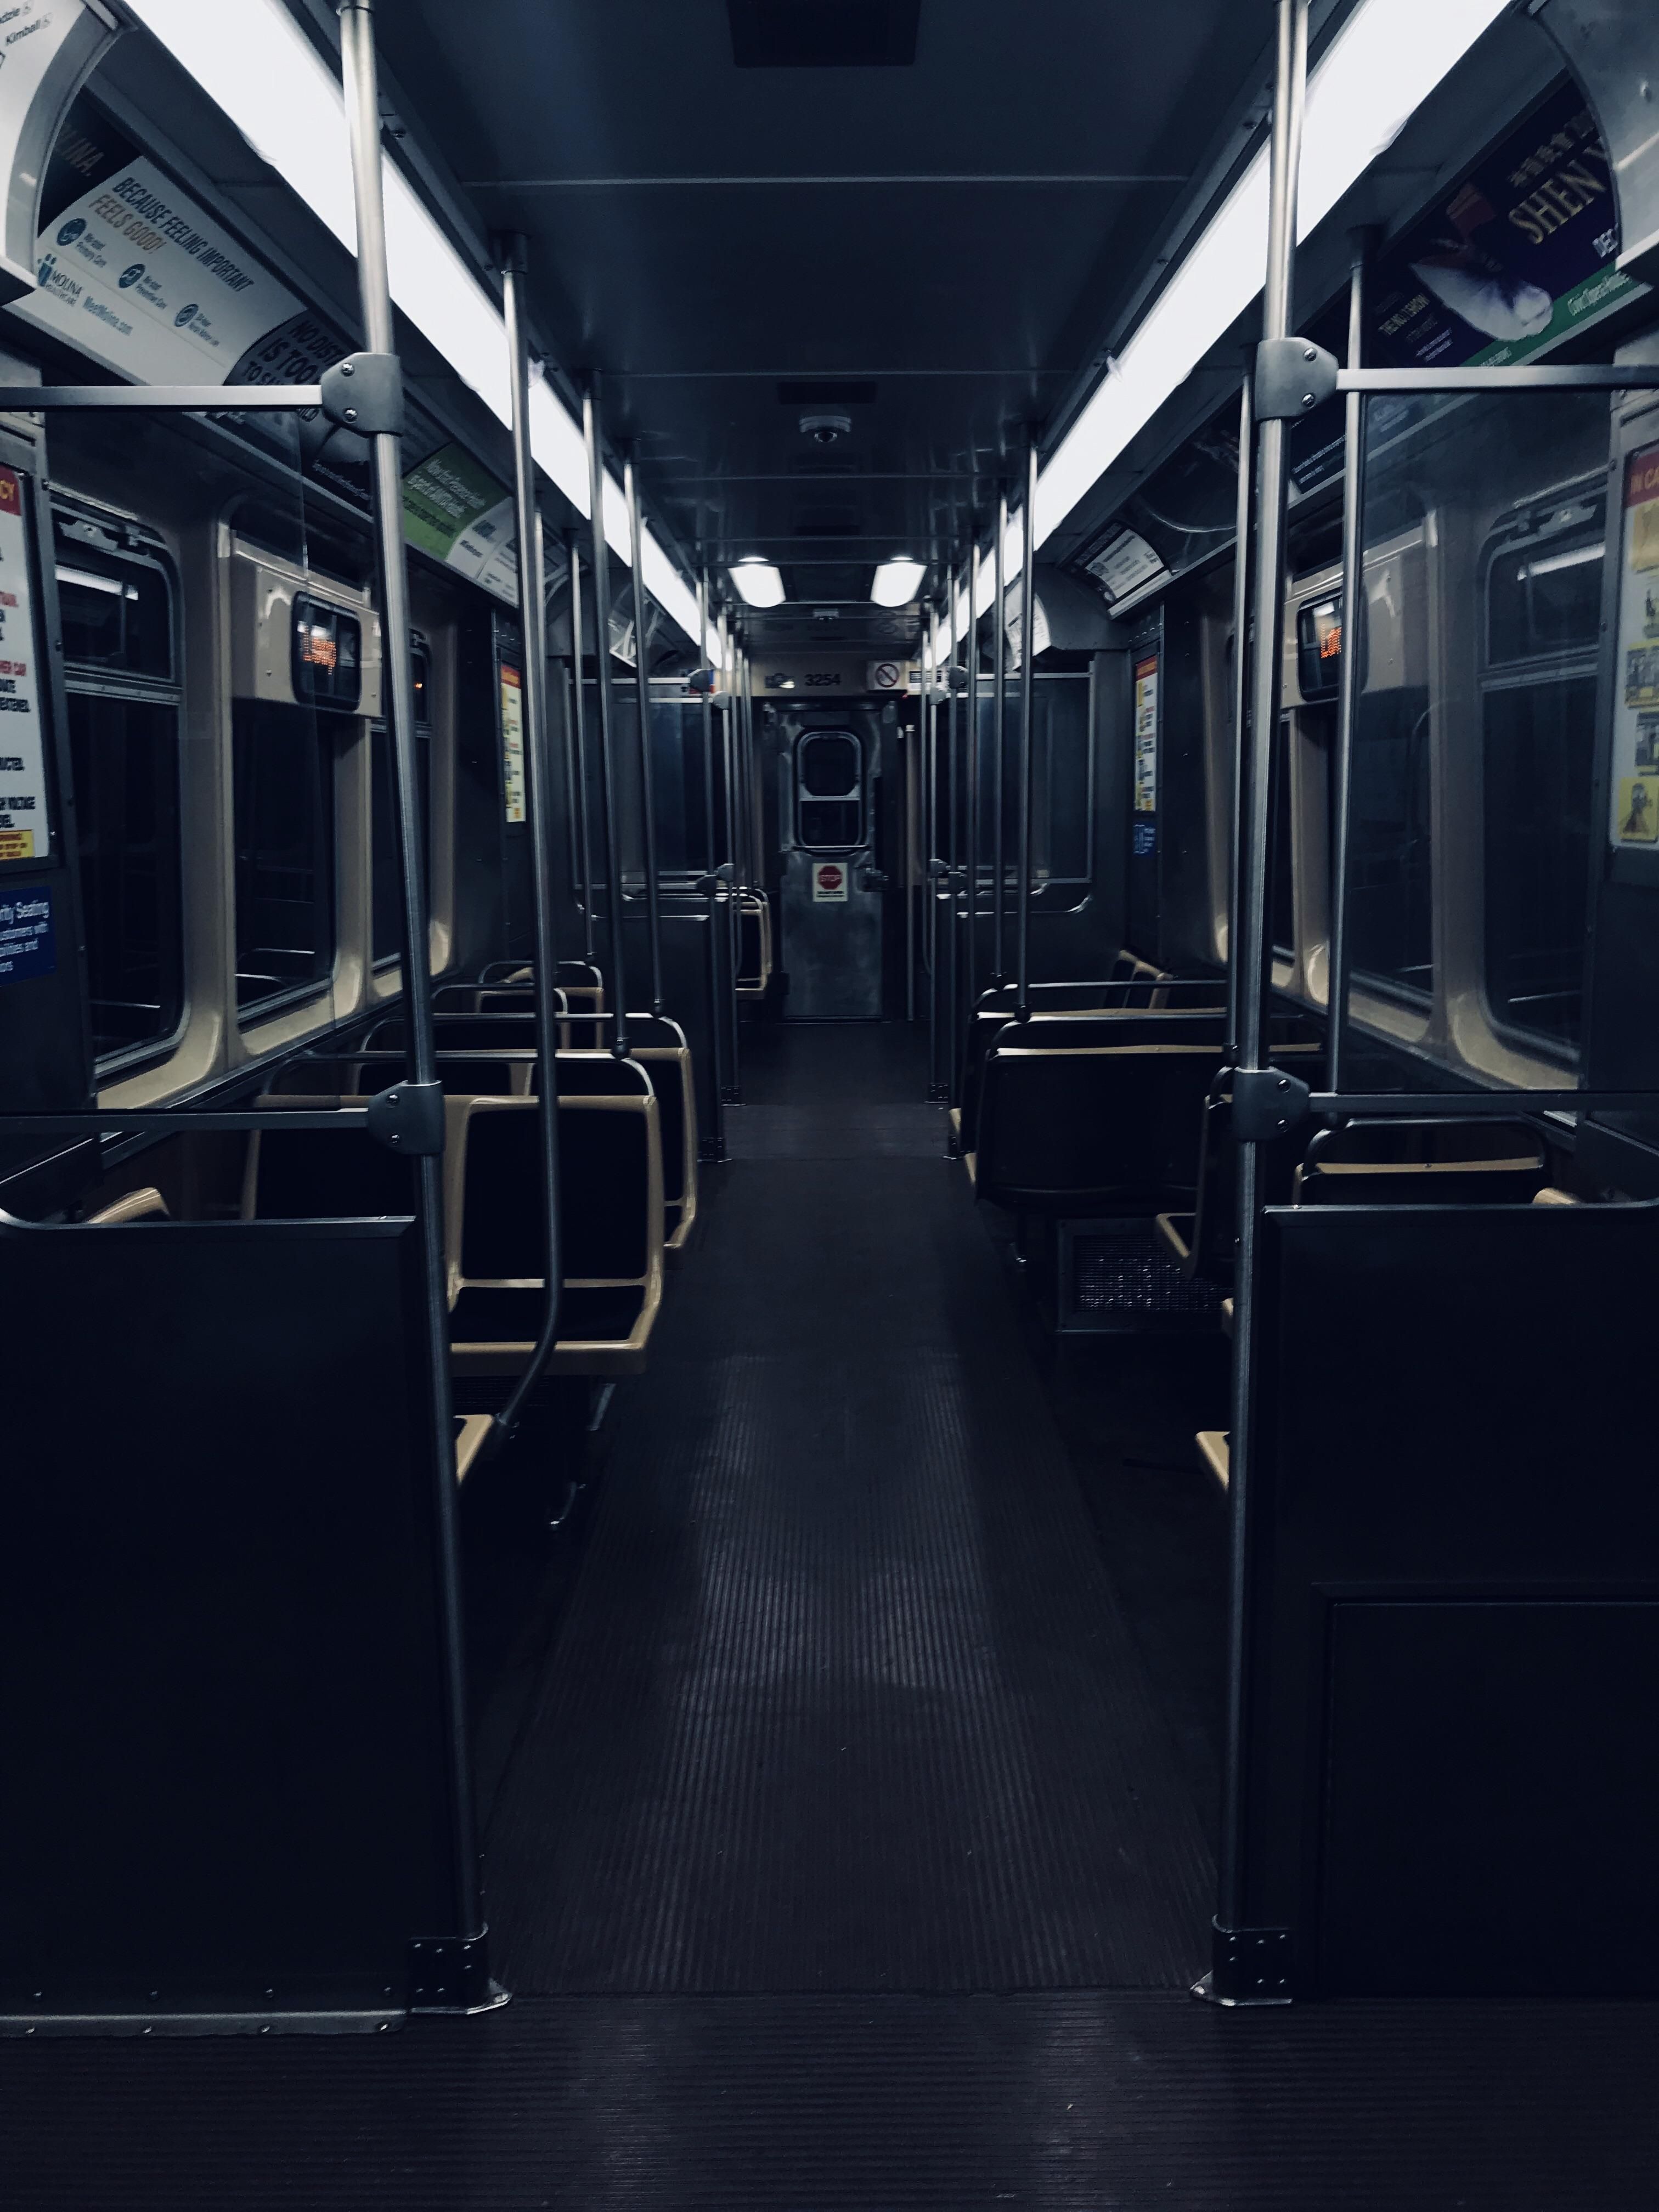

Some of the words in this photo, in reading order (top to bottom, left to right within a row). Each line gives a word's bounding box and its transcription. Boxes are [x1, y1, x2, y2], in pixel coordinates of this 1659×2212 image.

[5, 19, 41, 46] Kimball
[1508, 159, 1606, 245] SHEN
[88, 194, 134, 228] FEELS
[122, 221, 167, 254] GOOD!
[112, 177, 172, 224] BECAUSE
[157, 216, 208, 255] FEELING
[196, 247, 255, 292] IMPORTANT
[50, 269, 82, 297] MOLINA
[289, 320, 318, 344] NO
[257, 337, 290, 363] IS
[276, 348, 318, 383] TOO
[804, 674, 840, 686] 3254
